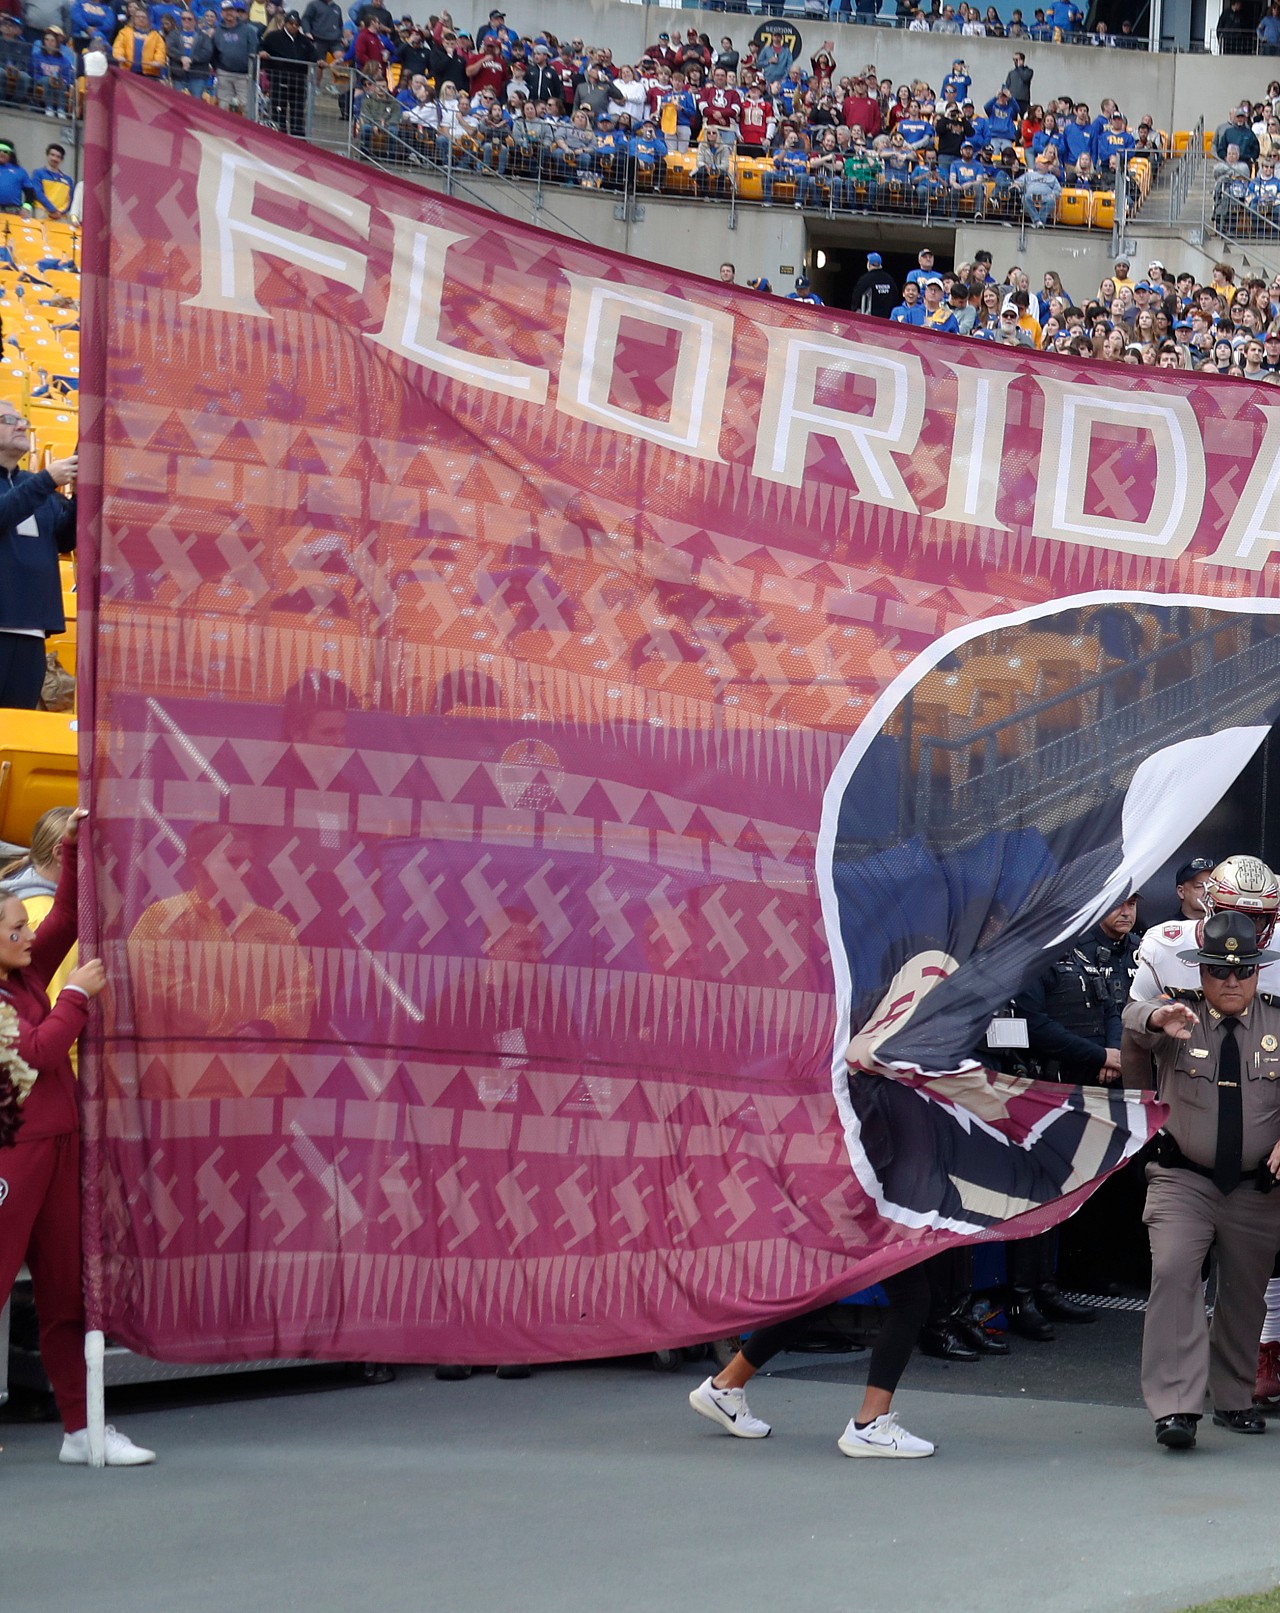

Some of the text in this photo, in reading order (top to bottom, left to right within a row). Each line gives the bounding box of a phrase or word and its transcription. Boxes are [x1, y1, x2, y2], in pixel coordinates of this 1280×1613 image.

[766, 26, 793, 35] SECTION
[761, 32, 796, 54] 27
[1106, 135, 1124, 146] Pitt
